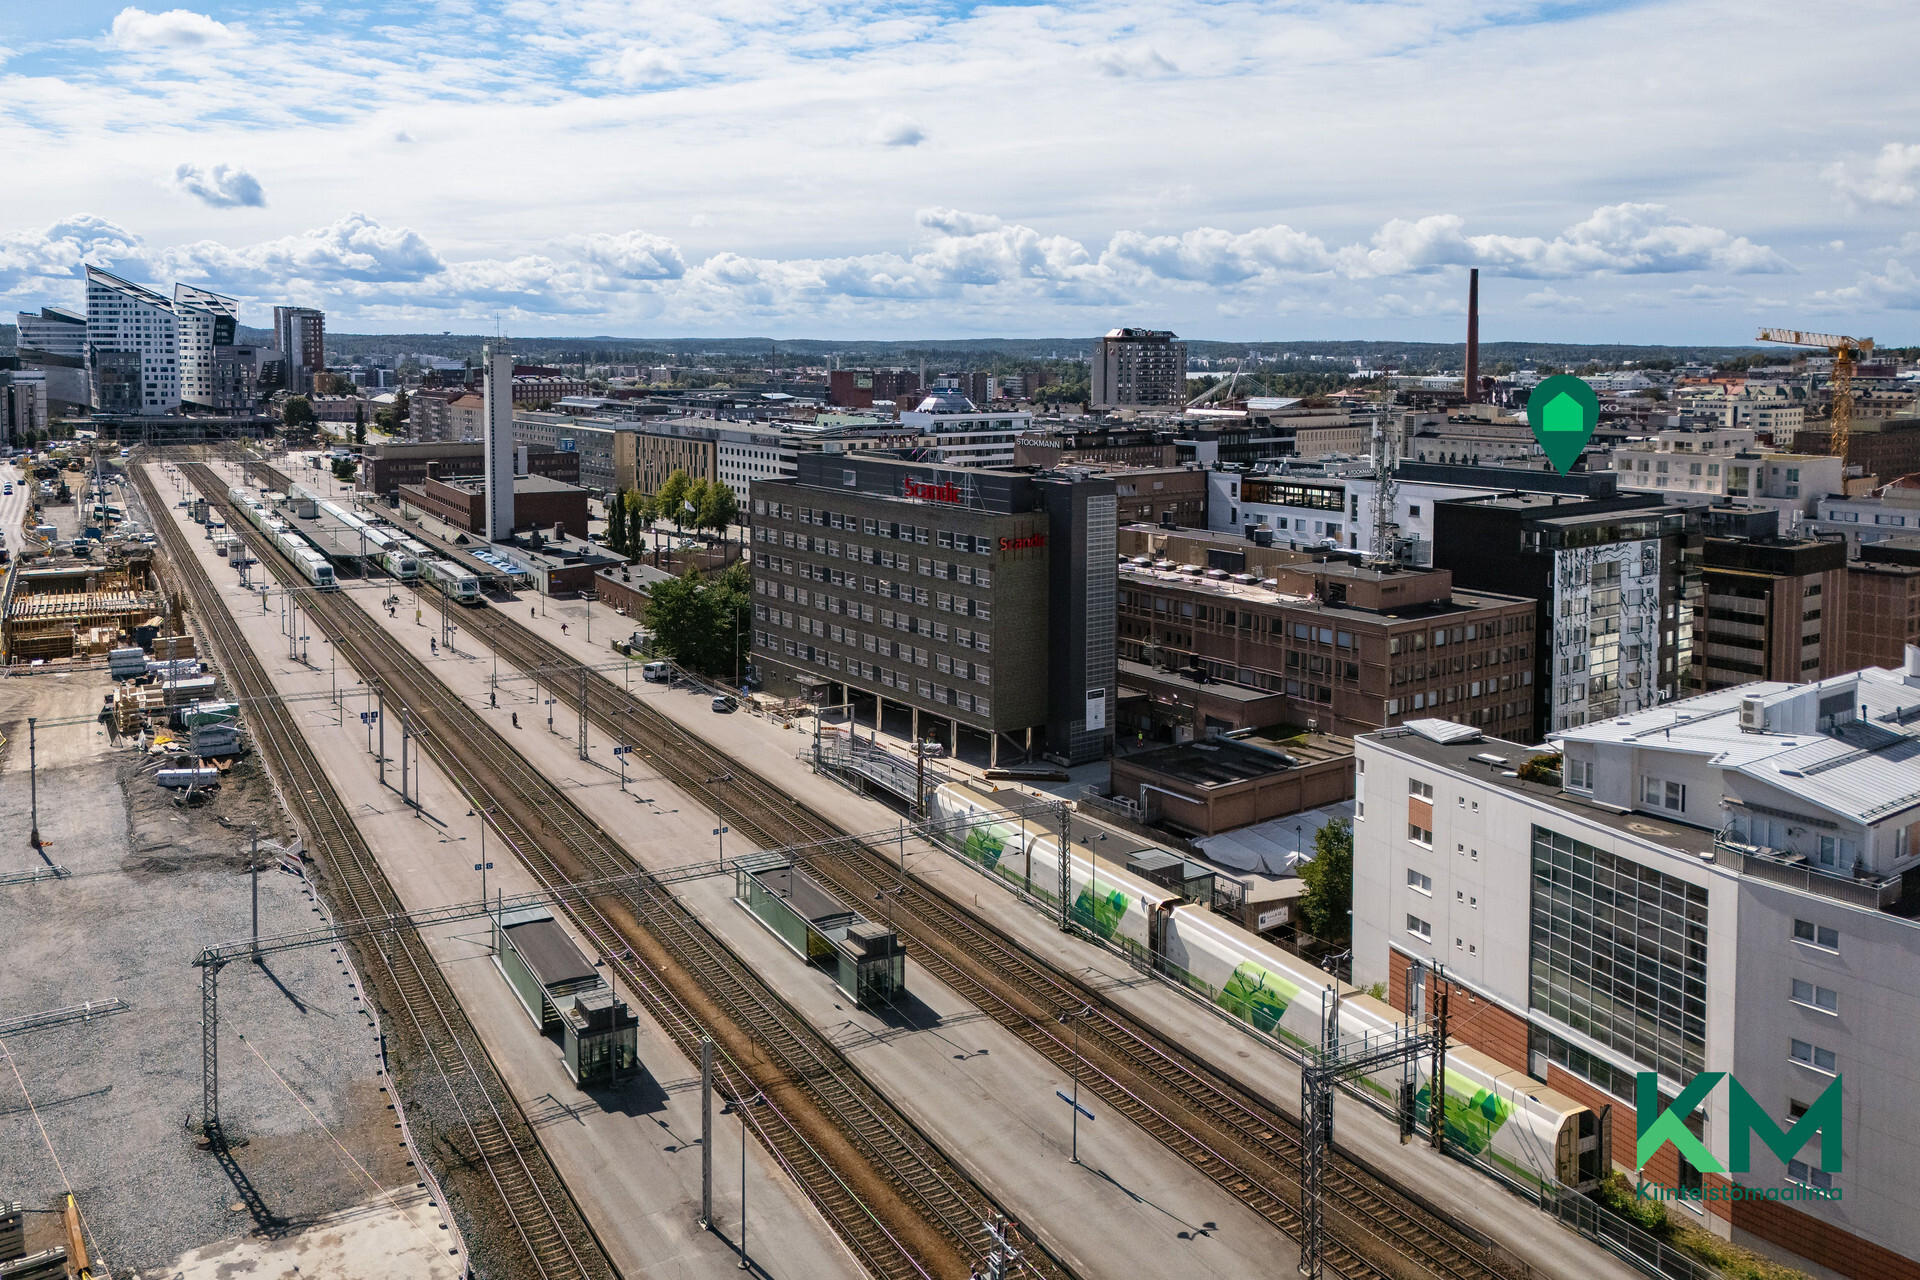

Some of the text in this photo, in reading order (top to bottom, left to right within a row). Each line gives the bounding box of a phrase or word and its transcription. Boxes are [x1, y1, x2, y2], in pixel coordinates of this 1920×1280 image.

[1016, 437, 1060, 448] STOCKMANN
[904, 477, 963, 504] Scandic
[1000, 533, 1047, 551] Scandic
